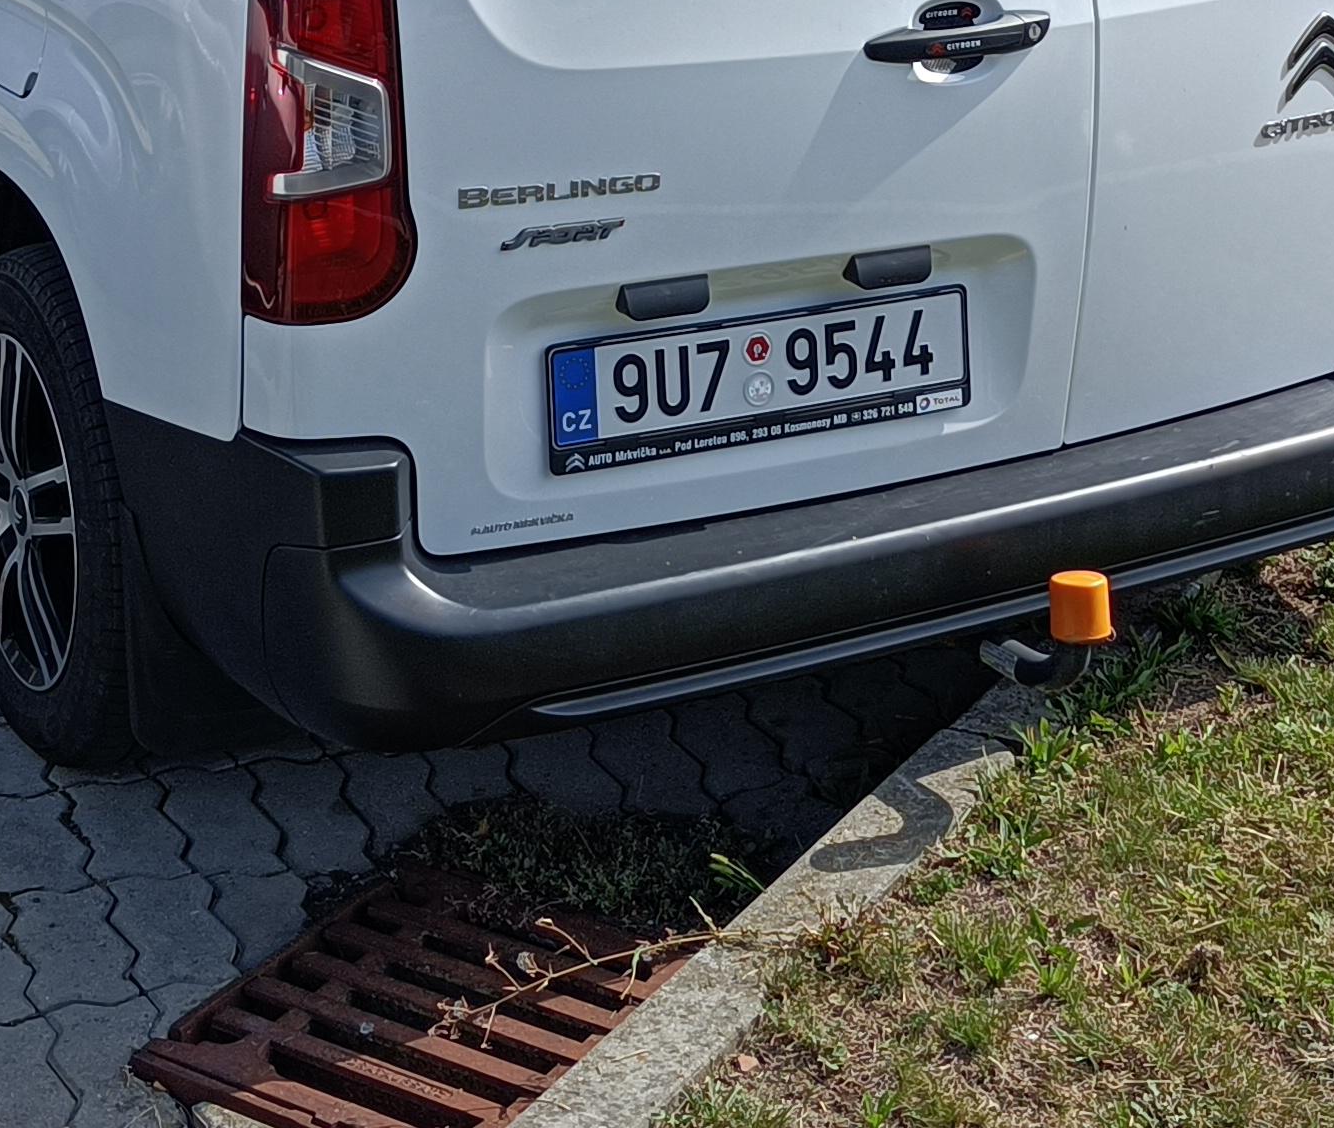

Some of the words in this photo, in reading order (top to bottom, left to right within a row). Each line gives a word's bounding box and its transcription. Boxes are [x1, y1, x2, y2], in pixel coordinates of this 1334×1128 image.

[458, 172, 661, 210] BERLINGO
[612, 338, 731, 423] 9U7
[785, 309, 934, 397] 9544
[933, 395, 961, 405] TOTAL
[561, 408, 592, 432] CZ
[588, 453, 612, 466] AUTO
[615, 447, 656, 462] Mrkvička
[675, 440, 691, 452] Pod
[752, 426, 768, 439] 293
[784, 417, 831, 433] Kosmonosy
[833, 413, 848, 424] MB
[880, 405, 895, 417] 721
